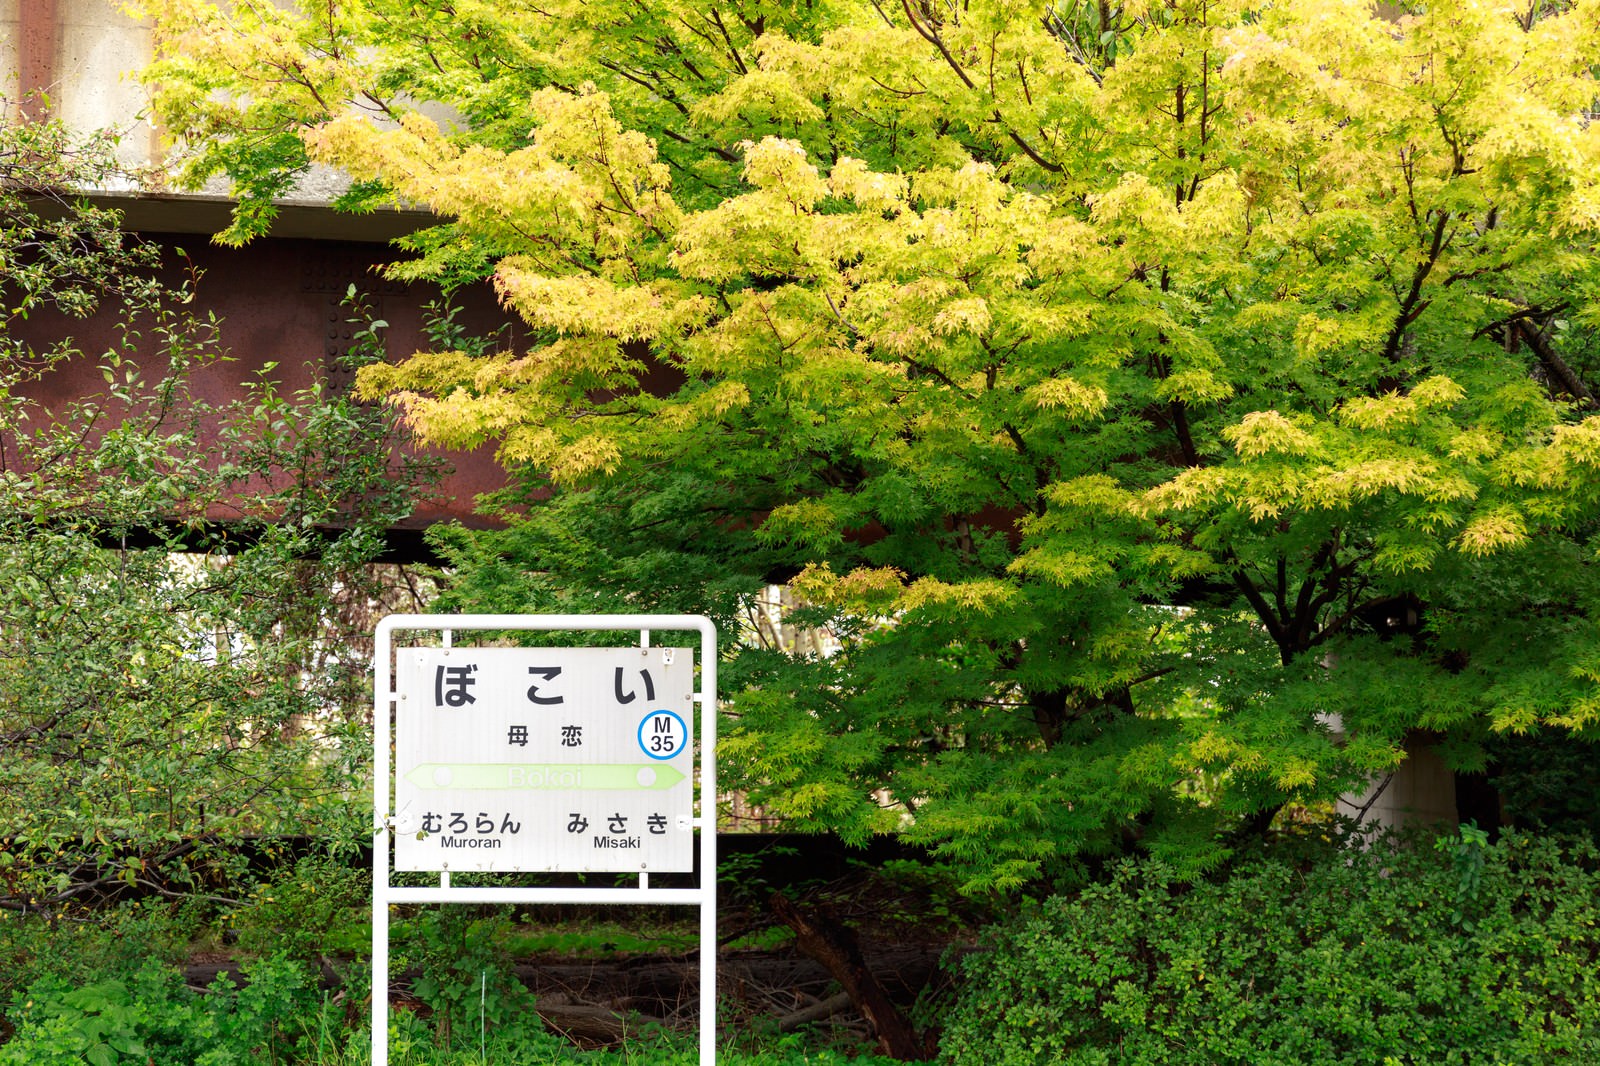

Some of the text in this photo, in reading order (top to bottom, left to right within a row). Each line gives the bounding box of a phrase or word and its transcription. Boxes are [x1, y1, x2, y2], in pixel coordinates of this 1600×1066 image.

[435, 664, 656, 706] ぼこい
[654, 716, 671, 733] M
[507, 725, 582, 746] 母恋
[650, 735, 674, 752] 35
[507, 766, 582, 788] Bokoi
[421, 811, 521, 834] むろらん
[567, 812, 668, 834] みさき
[440, 836, 501, 849] Muroran
[593, 836, 641, 849] Misaki
